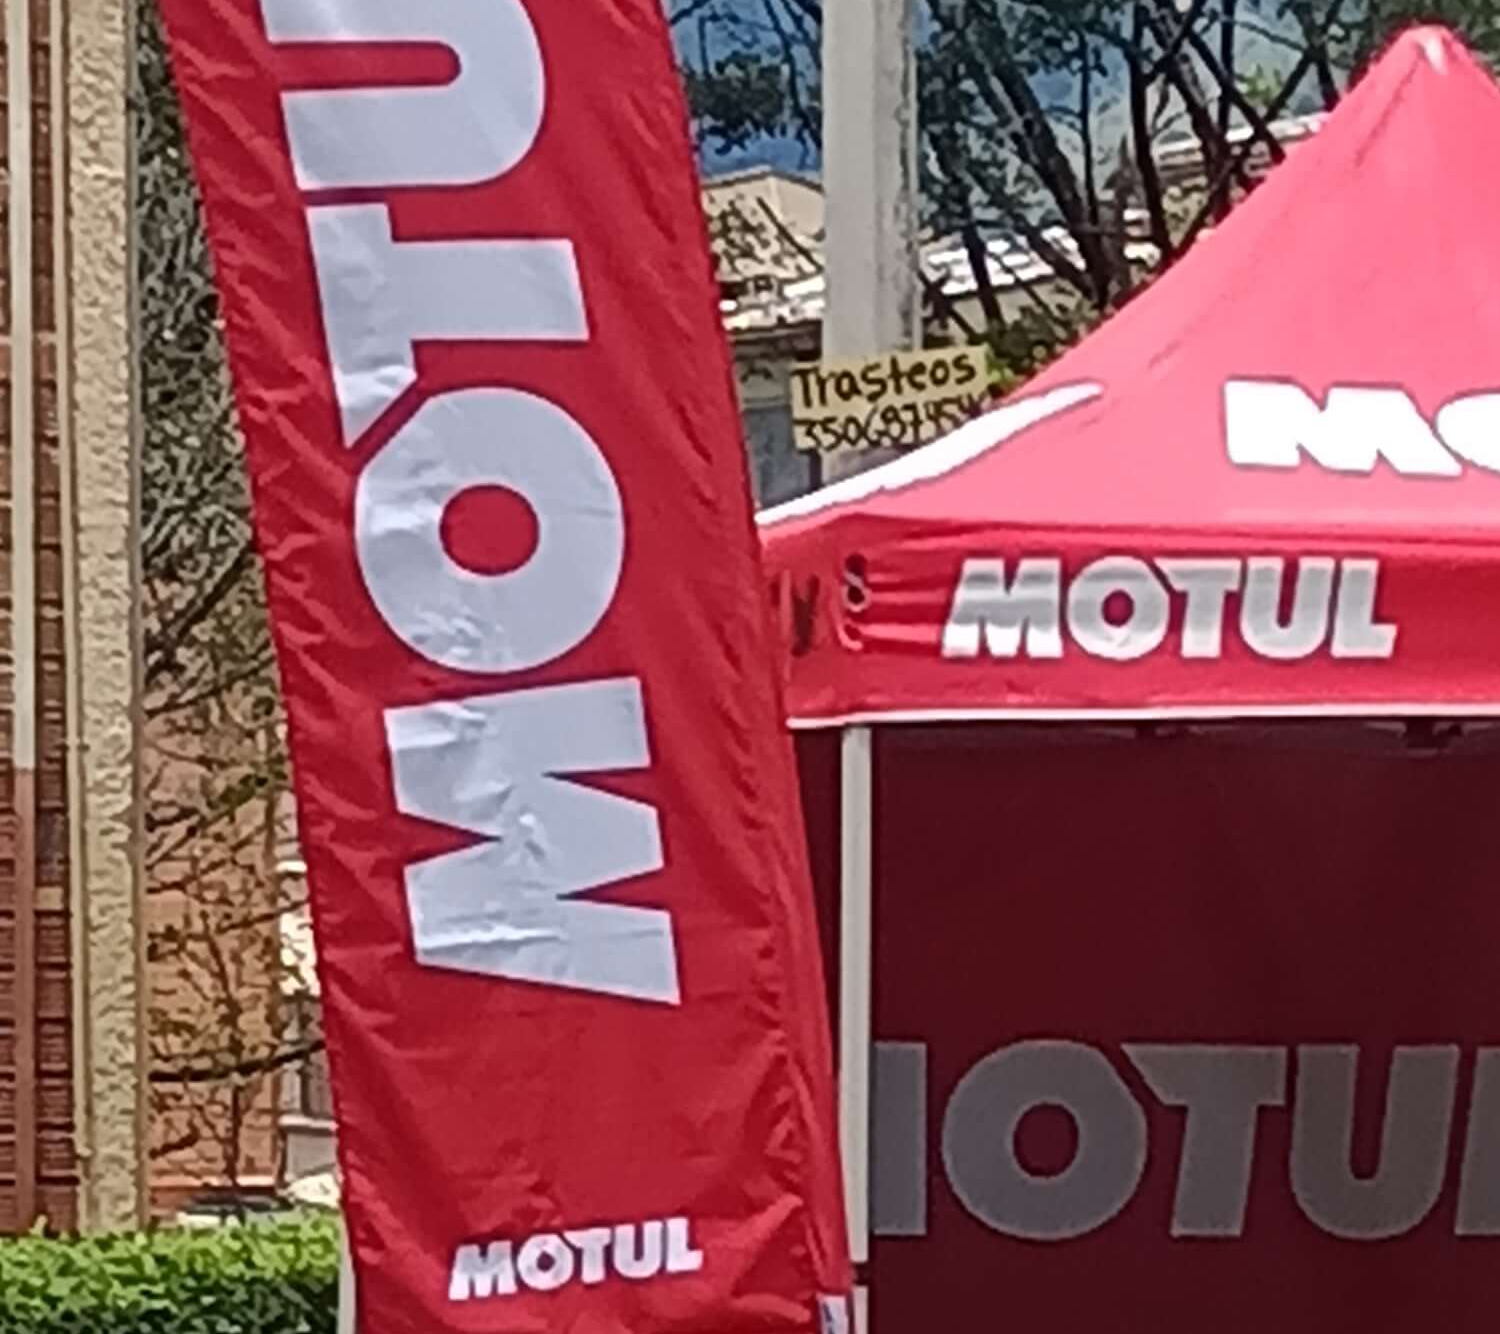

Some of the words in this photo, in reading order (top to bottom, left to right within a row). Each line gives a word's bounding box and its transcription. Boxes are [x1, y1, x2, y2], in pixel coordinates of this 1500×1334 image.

[790, 353, 977, 408] Trasteos
[940, 554, 1398, 660] MOTUL
[448, 1216, 704, 1301] MOTUL
